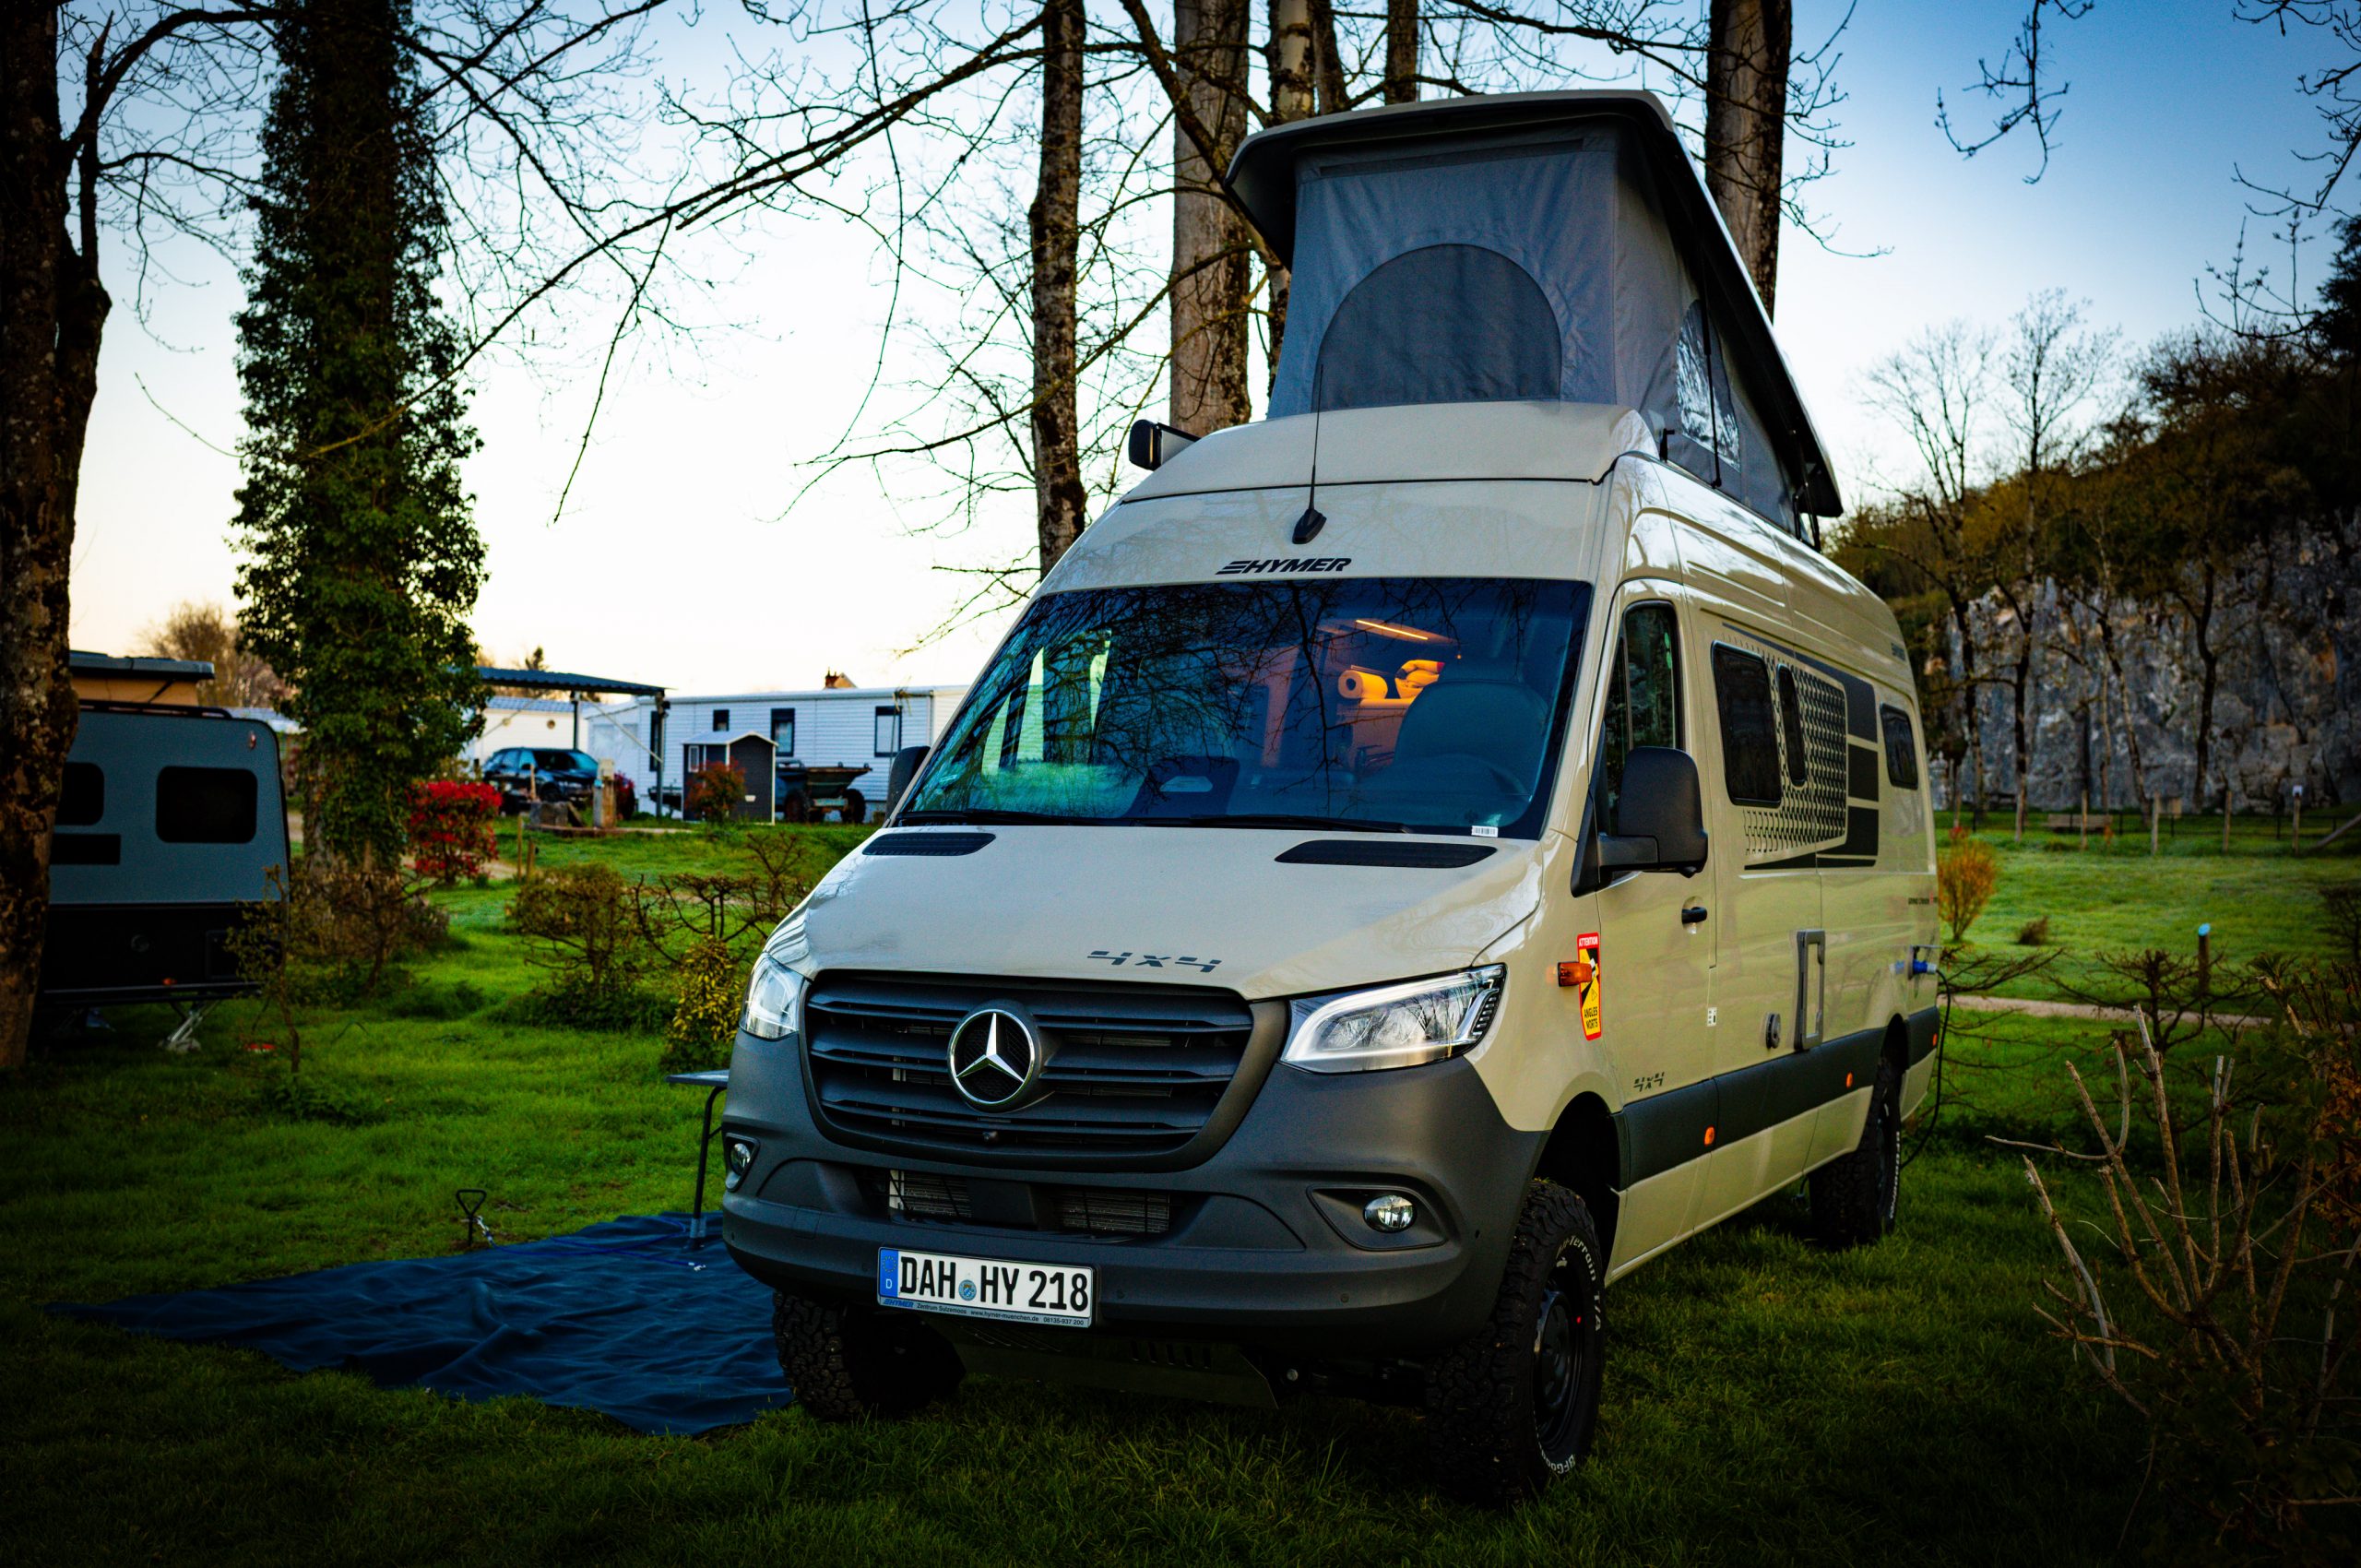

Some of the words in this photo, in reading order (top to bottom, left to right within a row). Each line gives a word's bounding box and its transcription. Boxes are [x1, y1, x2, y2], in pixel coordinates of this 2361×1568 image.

[1215, 557, 1353, 576] HYMER
[885, 1278, 893, 1289] D
[899, 1255, 956, 1300] DAH
[979, 1265, 1020, 1306] HY
[1027, 1269, 1089, 1313] 218
[883, 1299, 914, 1308] HYMER
